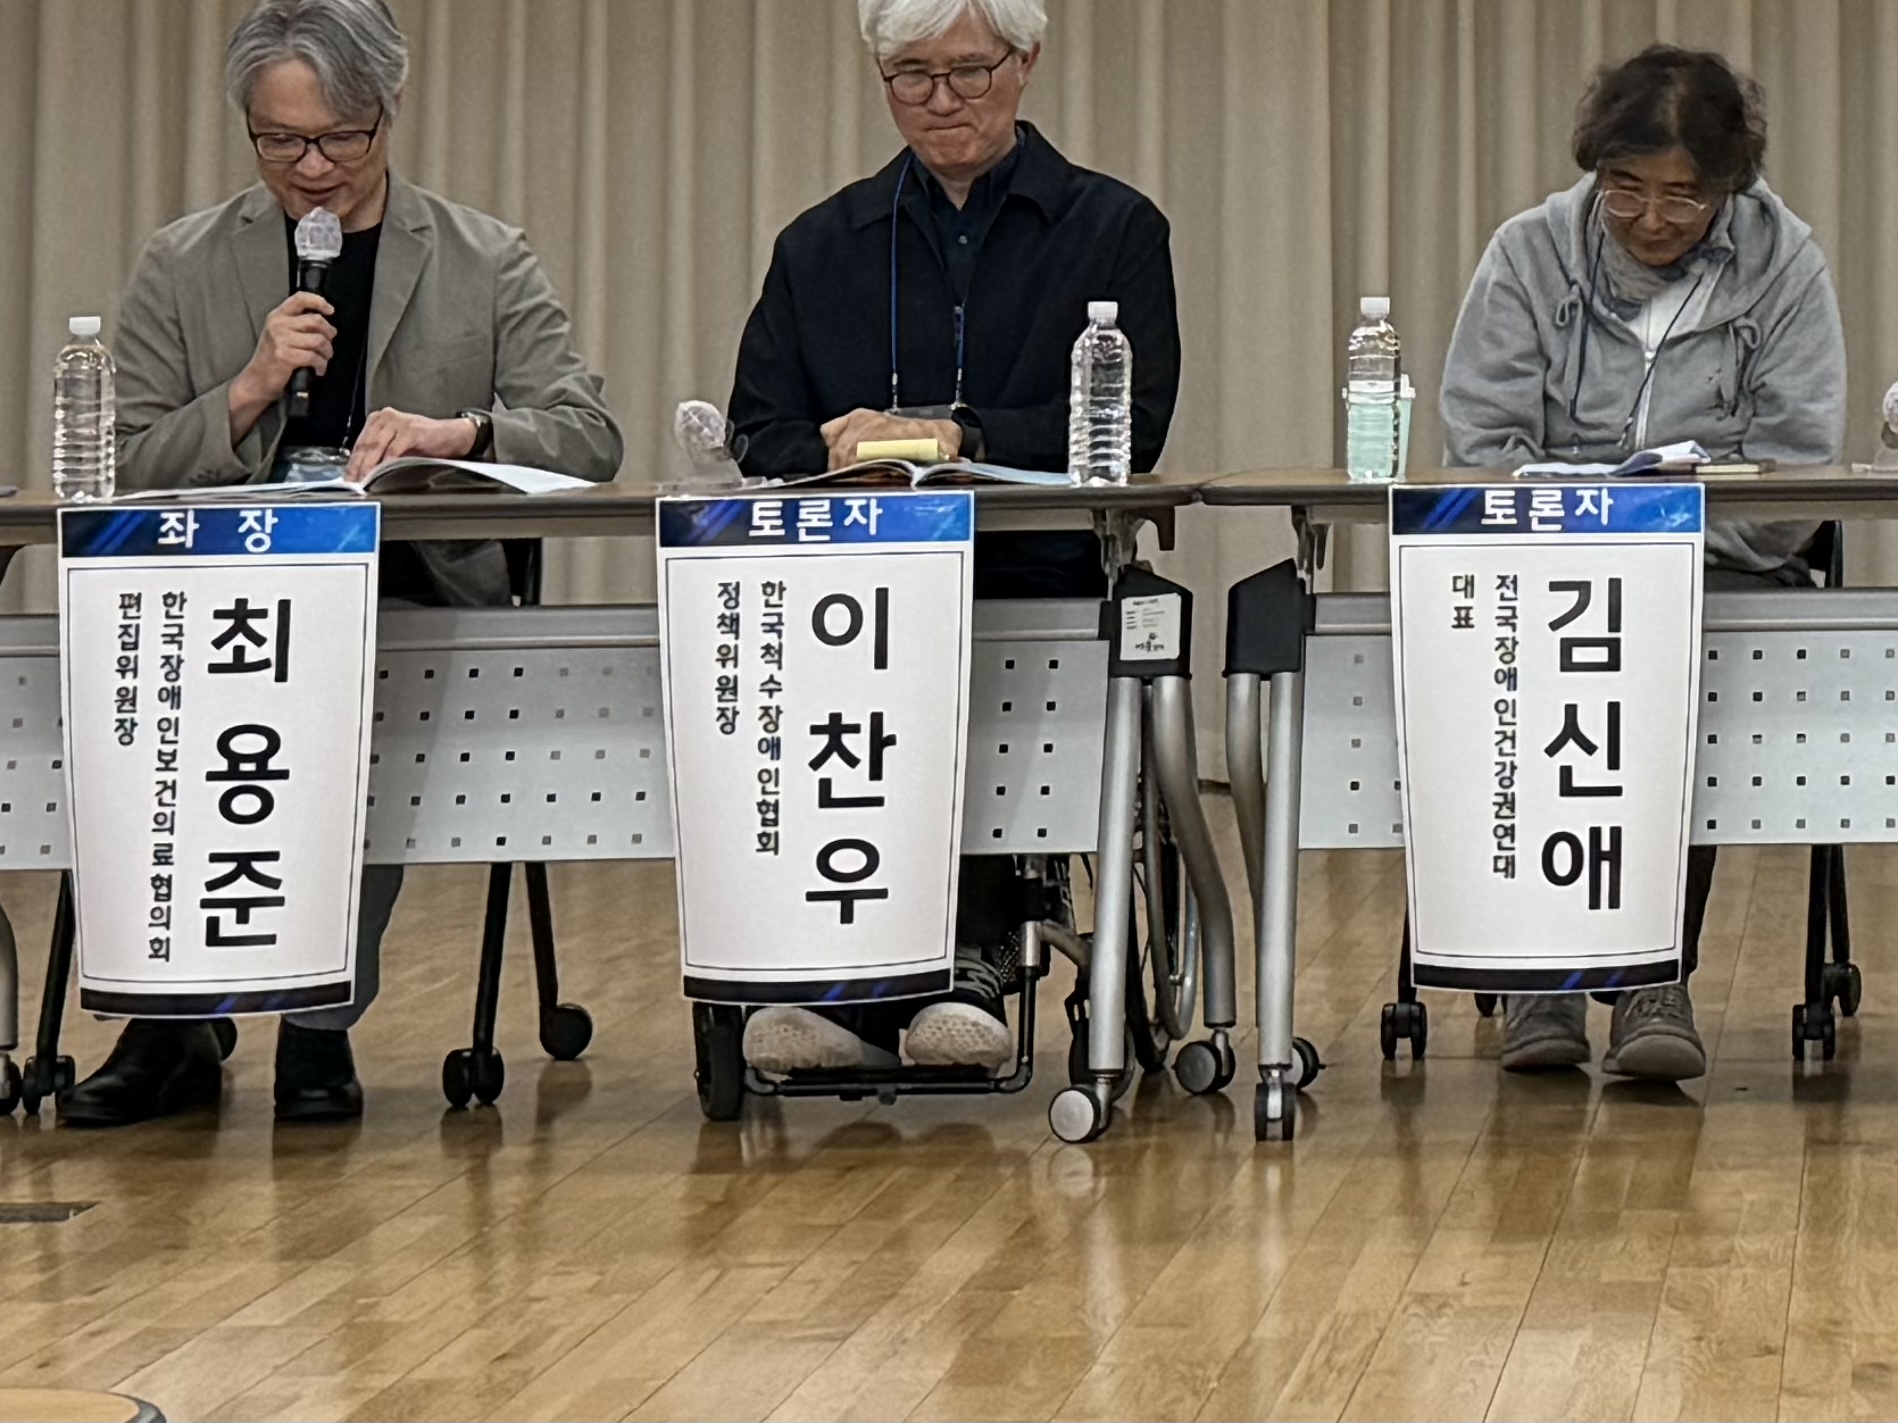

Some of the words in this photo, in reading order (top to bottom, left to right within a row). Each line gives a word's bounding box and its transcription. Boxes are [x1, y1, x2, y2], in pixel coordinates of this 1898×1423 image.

[748, 498, 884, 543] 토론자
[1450, 574, 1475, 630] 대표
[1481, 488, 1614, 532] 토론자
[113, 591, 143, 747] 편집위원장
[147, 590, 188, 963] 한국장애인보건의료협의회
[199, 597, 292, 948] 최용준
[714, 581, 741, 736] 정책위원장
[755, 580, 787, 856] 한국척수장애인협회
[805, 587, 897, 925] 이찬우
[1491, 574, 1520, 880] 전국장애인건강권연대
[1541, 577, 1624, 911] 김신애
